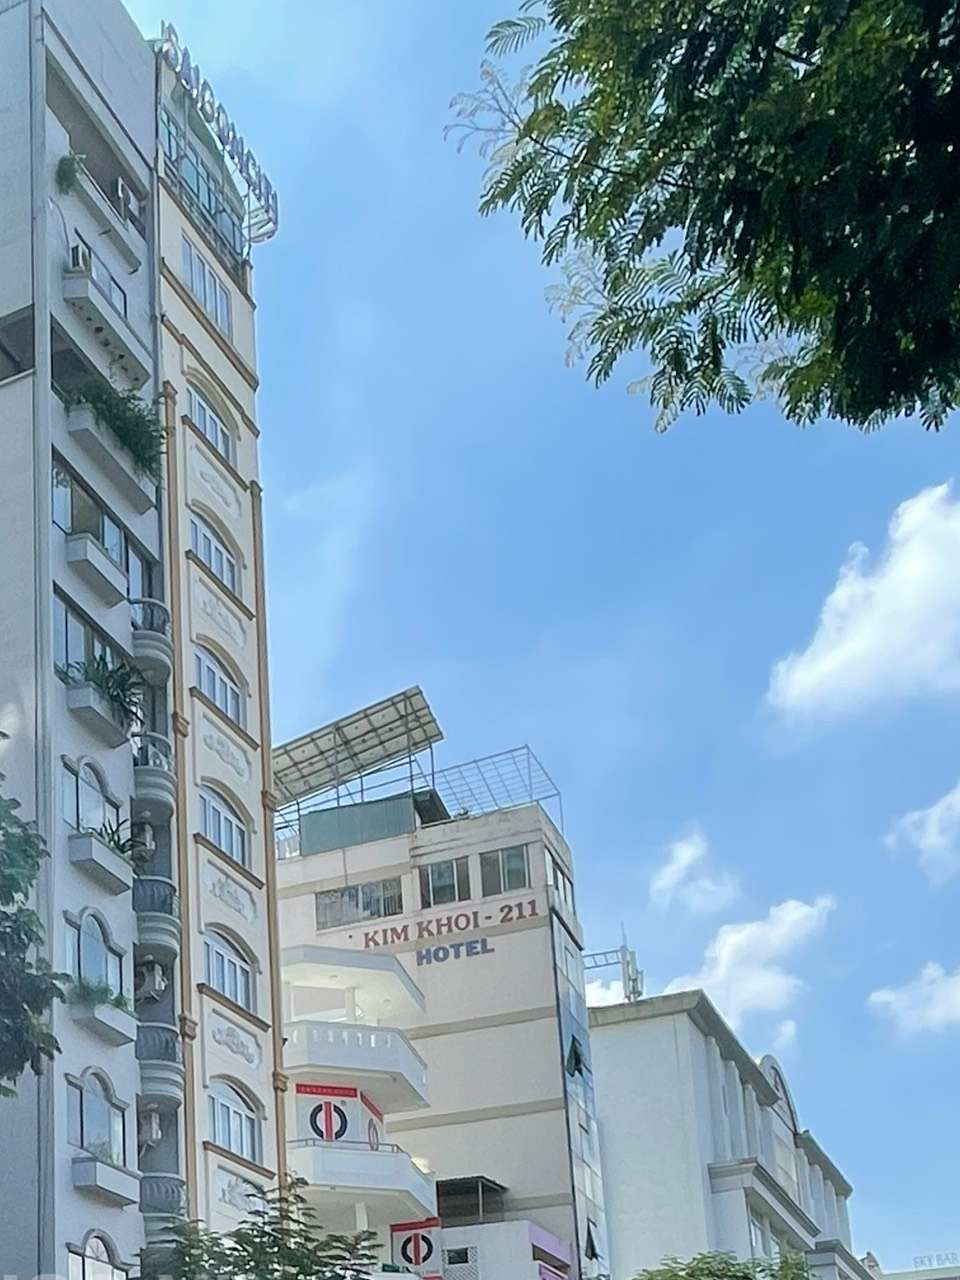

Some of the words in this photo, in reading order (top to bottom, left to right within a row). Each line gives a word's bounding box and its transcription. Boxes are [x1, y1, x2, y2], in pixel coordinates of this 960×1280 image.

[364, 925, 409, 948] KIM
[416, 911, 480, 938] KHOI
[500, 900, 539, 923] 211
[416, 938, 495, 966] HOTEL
